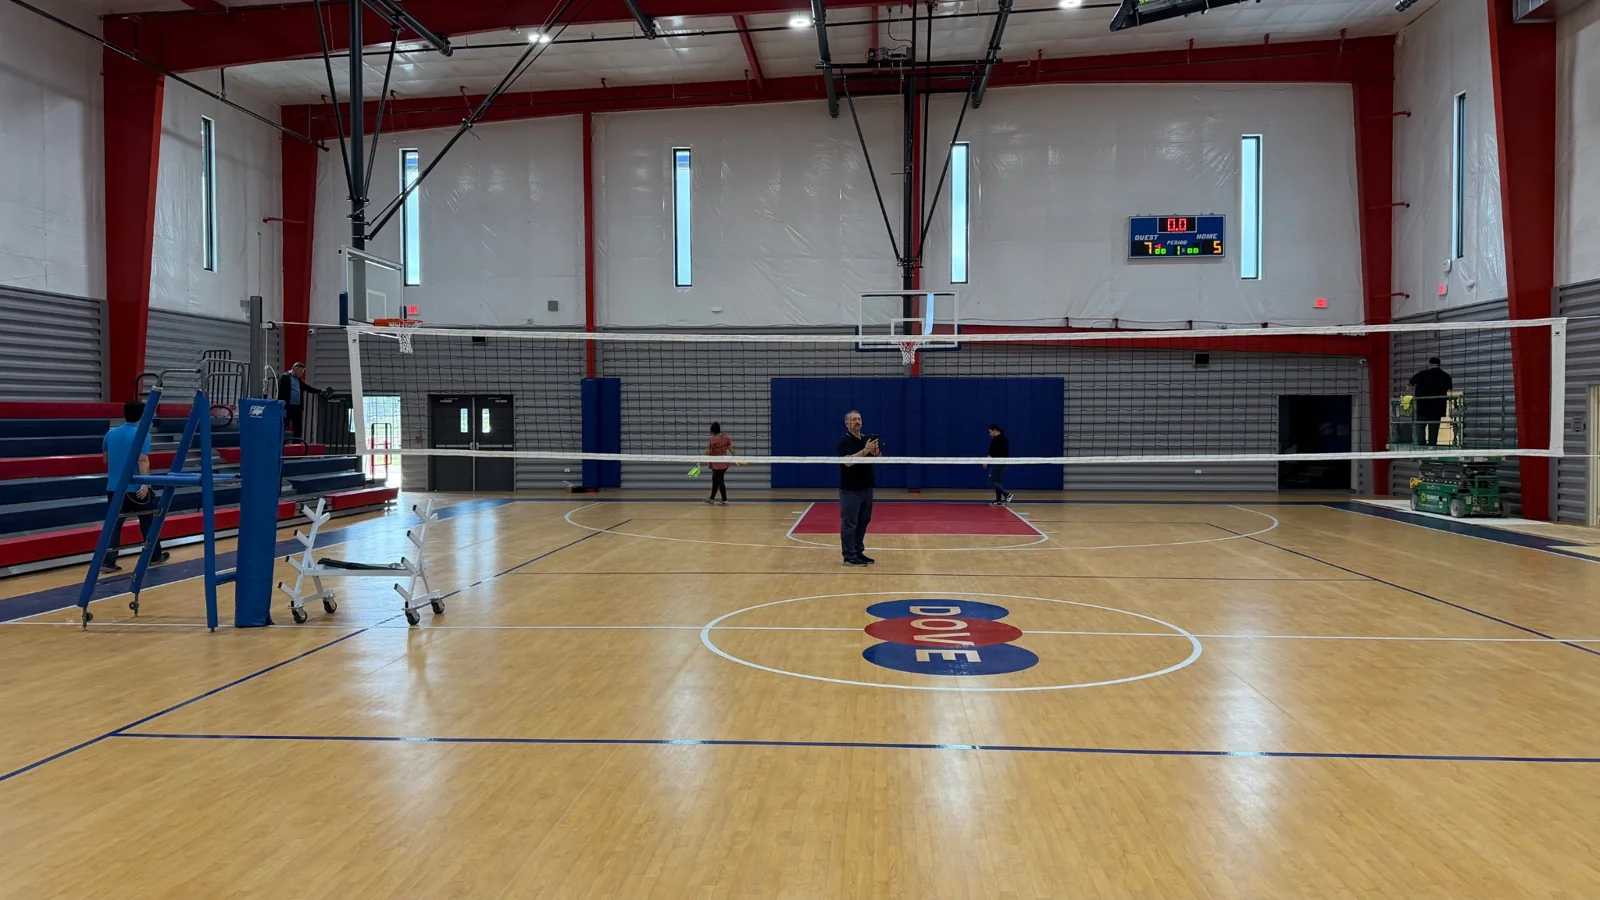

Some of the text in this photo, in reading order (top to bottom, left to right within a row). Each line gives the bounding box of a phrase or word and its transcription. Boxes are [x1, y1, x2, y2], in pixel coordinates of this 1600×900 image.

[1167, 218, 1187, 231] 0.0
[1144, 241, 1153, 255] 7
[1213, 240, 1222, 254] 5
[909, 605, 981, 662] DOVE
